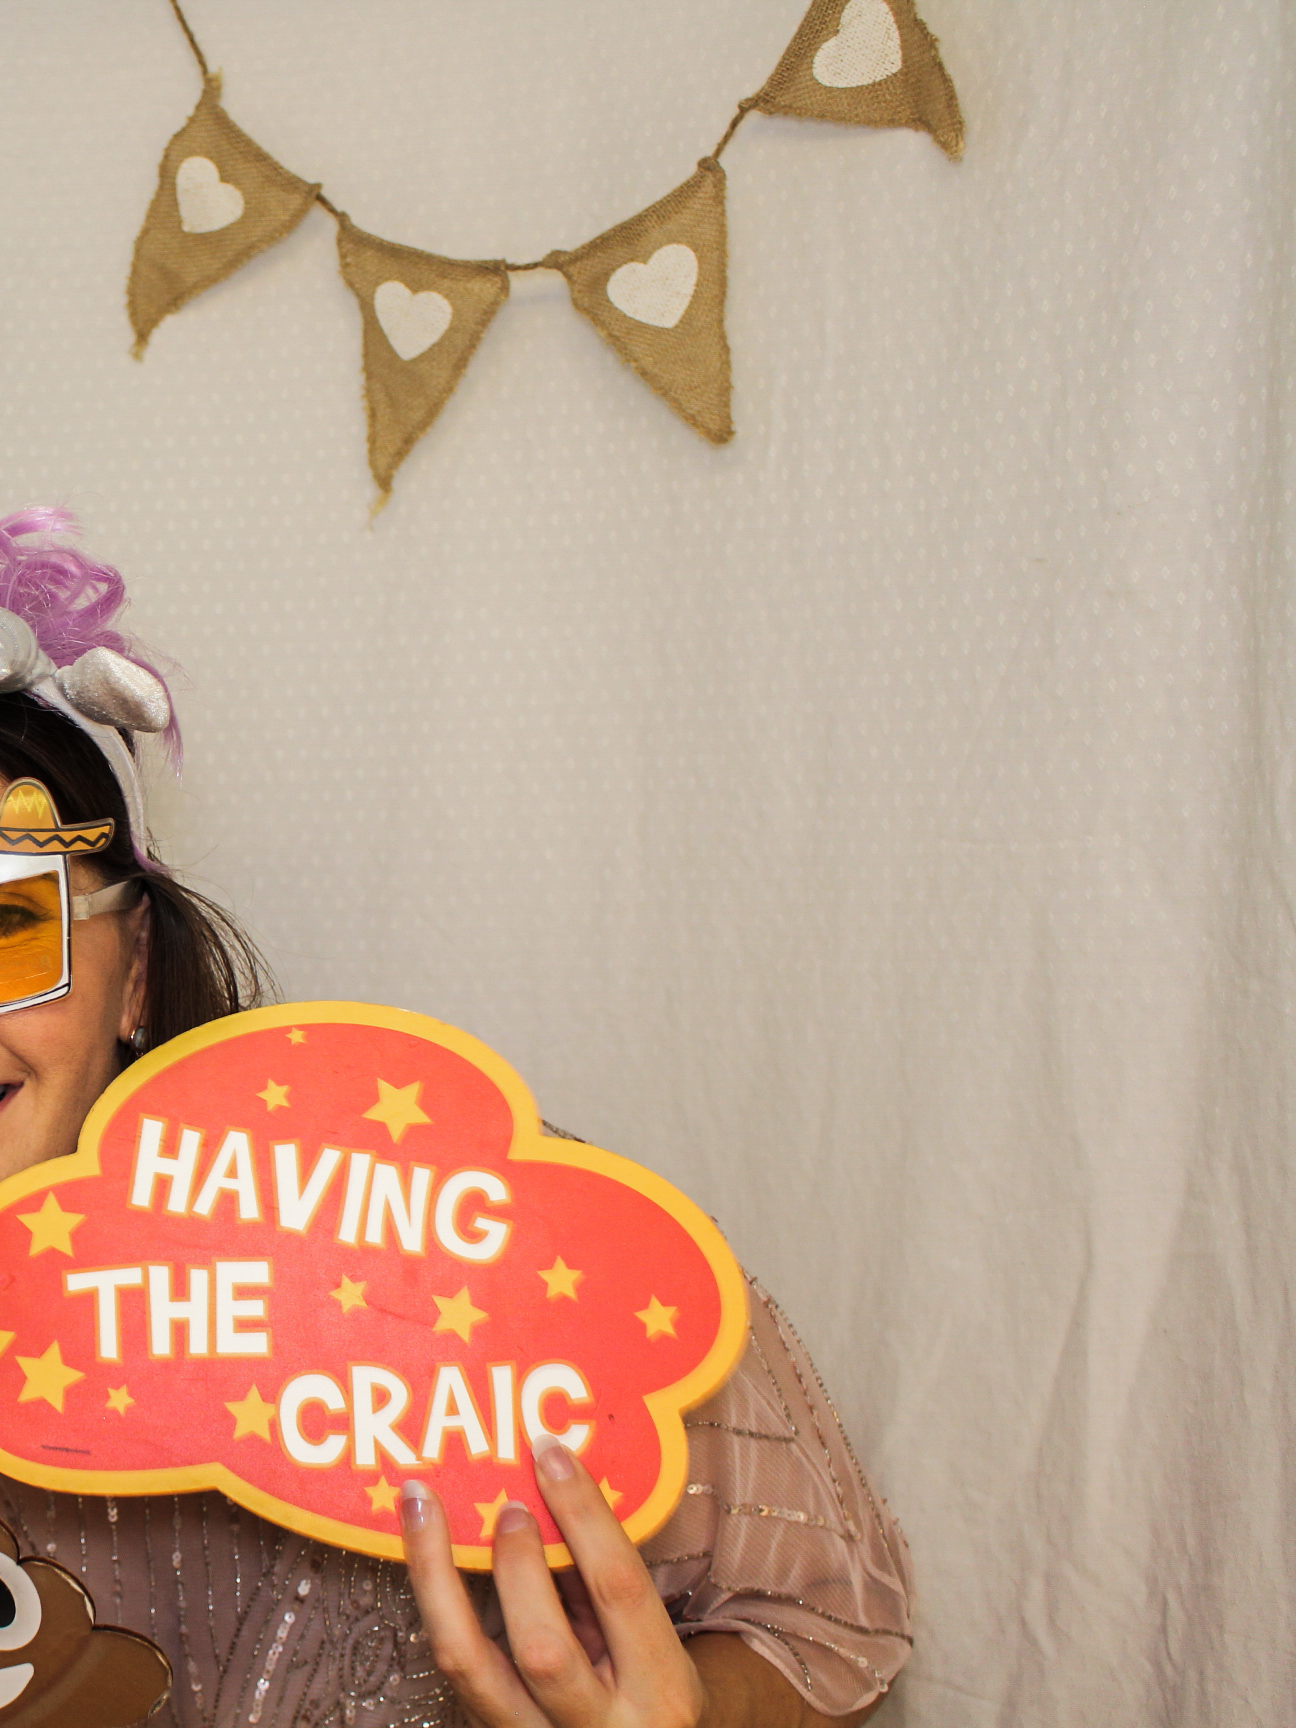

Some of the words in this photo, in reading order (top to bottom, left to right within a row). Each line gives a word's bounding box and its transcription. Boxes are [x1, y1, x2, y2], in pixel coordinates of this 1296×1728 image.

[130, 1117, 512, 1261] HAVING
[66, 1261, 270, 1359] THE
[278, 1364, 591, 1467] CRAIC
